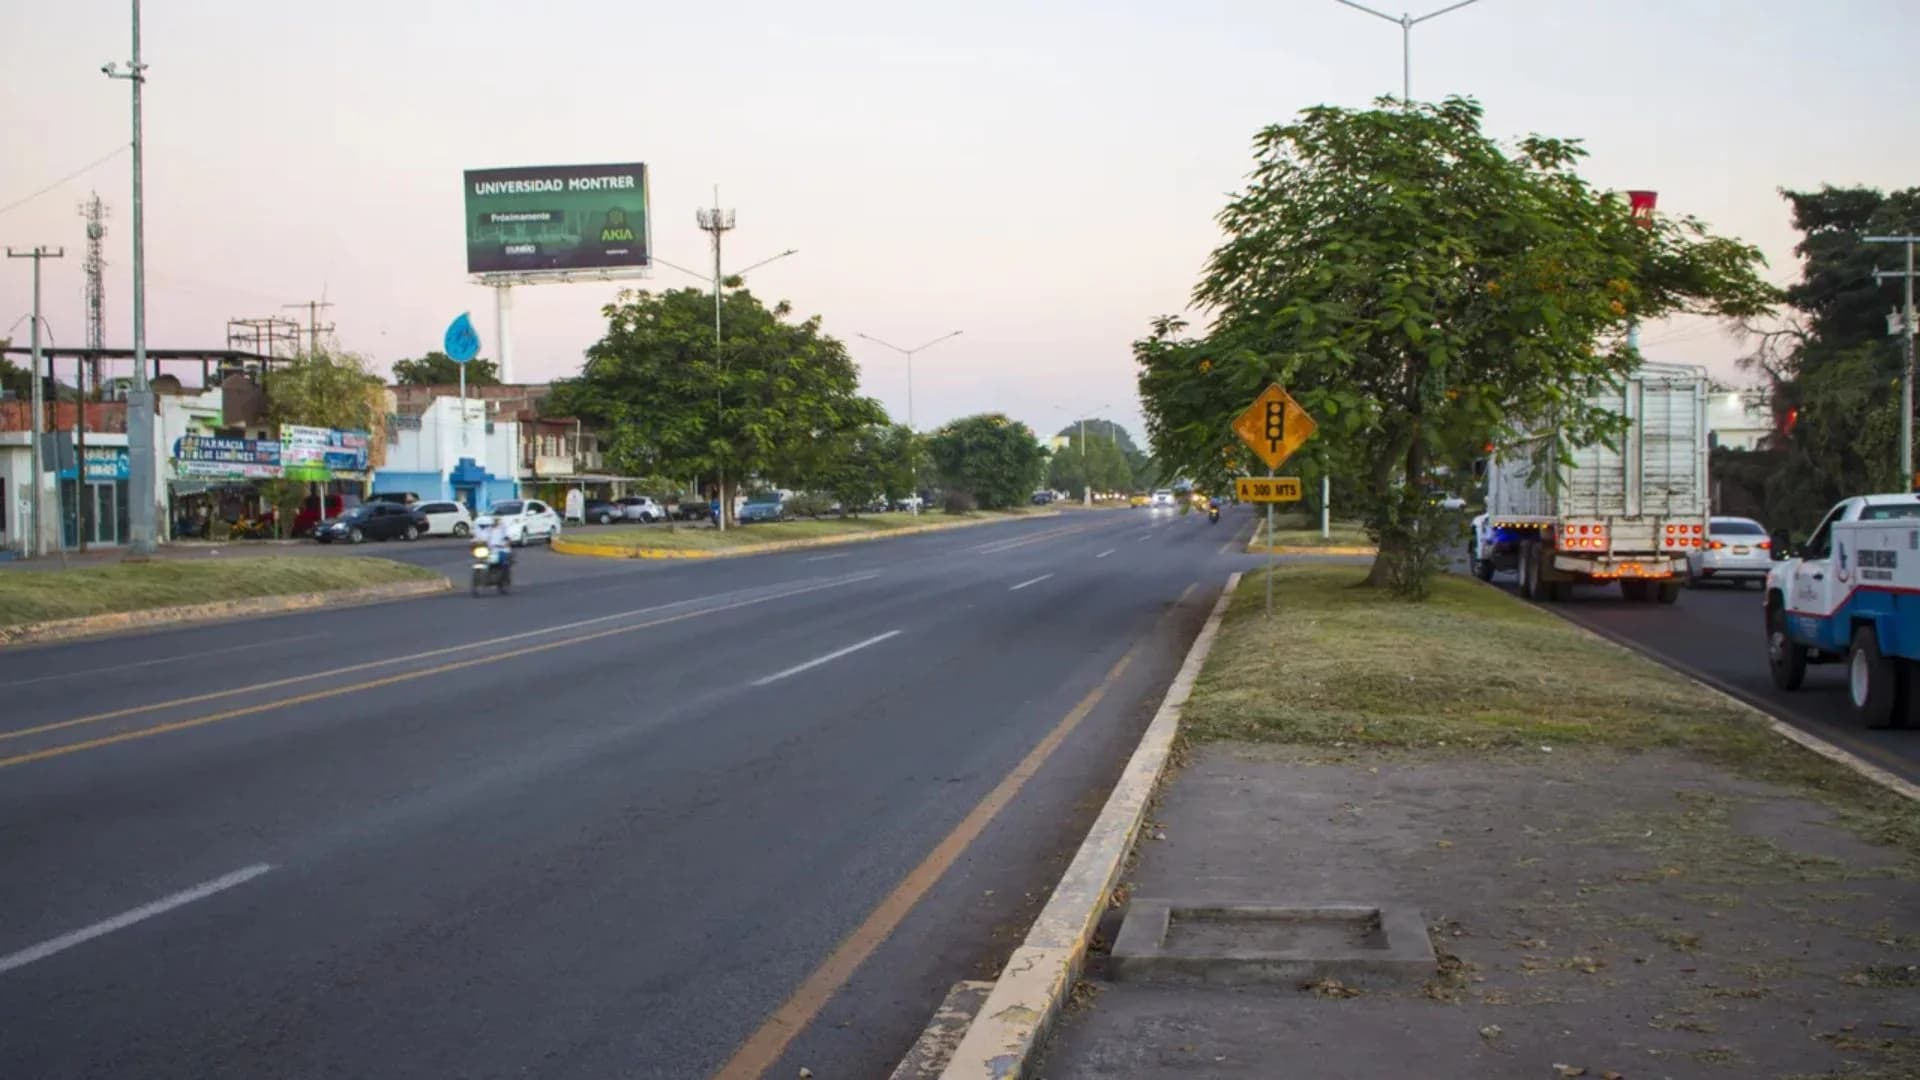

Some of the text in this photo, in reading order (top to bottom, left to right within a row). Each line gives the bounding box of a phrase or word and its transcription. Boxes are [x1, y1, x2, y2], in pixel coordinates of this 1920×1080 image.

[475, 175, 635, 195] UNIVERSIDAD MONTRER
[200, 438, 244, 450] FARMACIA
[1241, 484, 1297, 496] A 300 MTS
